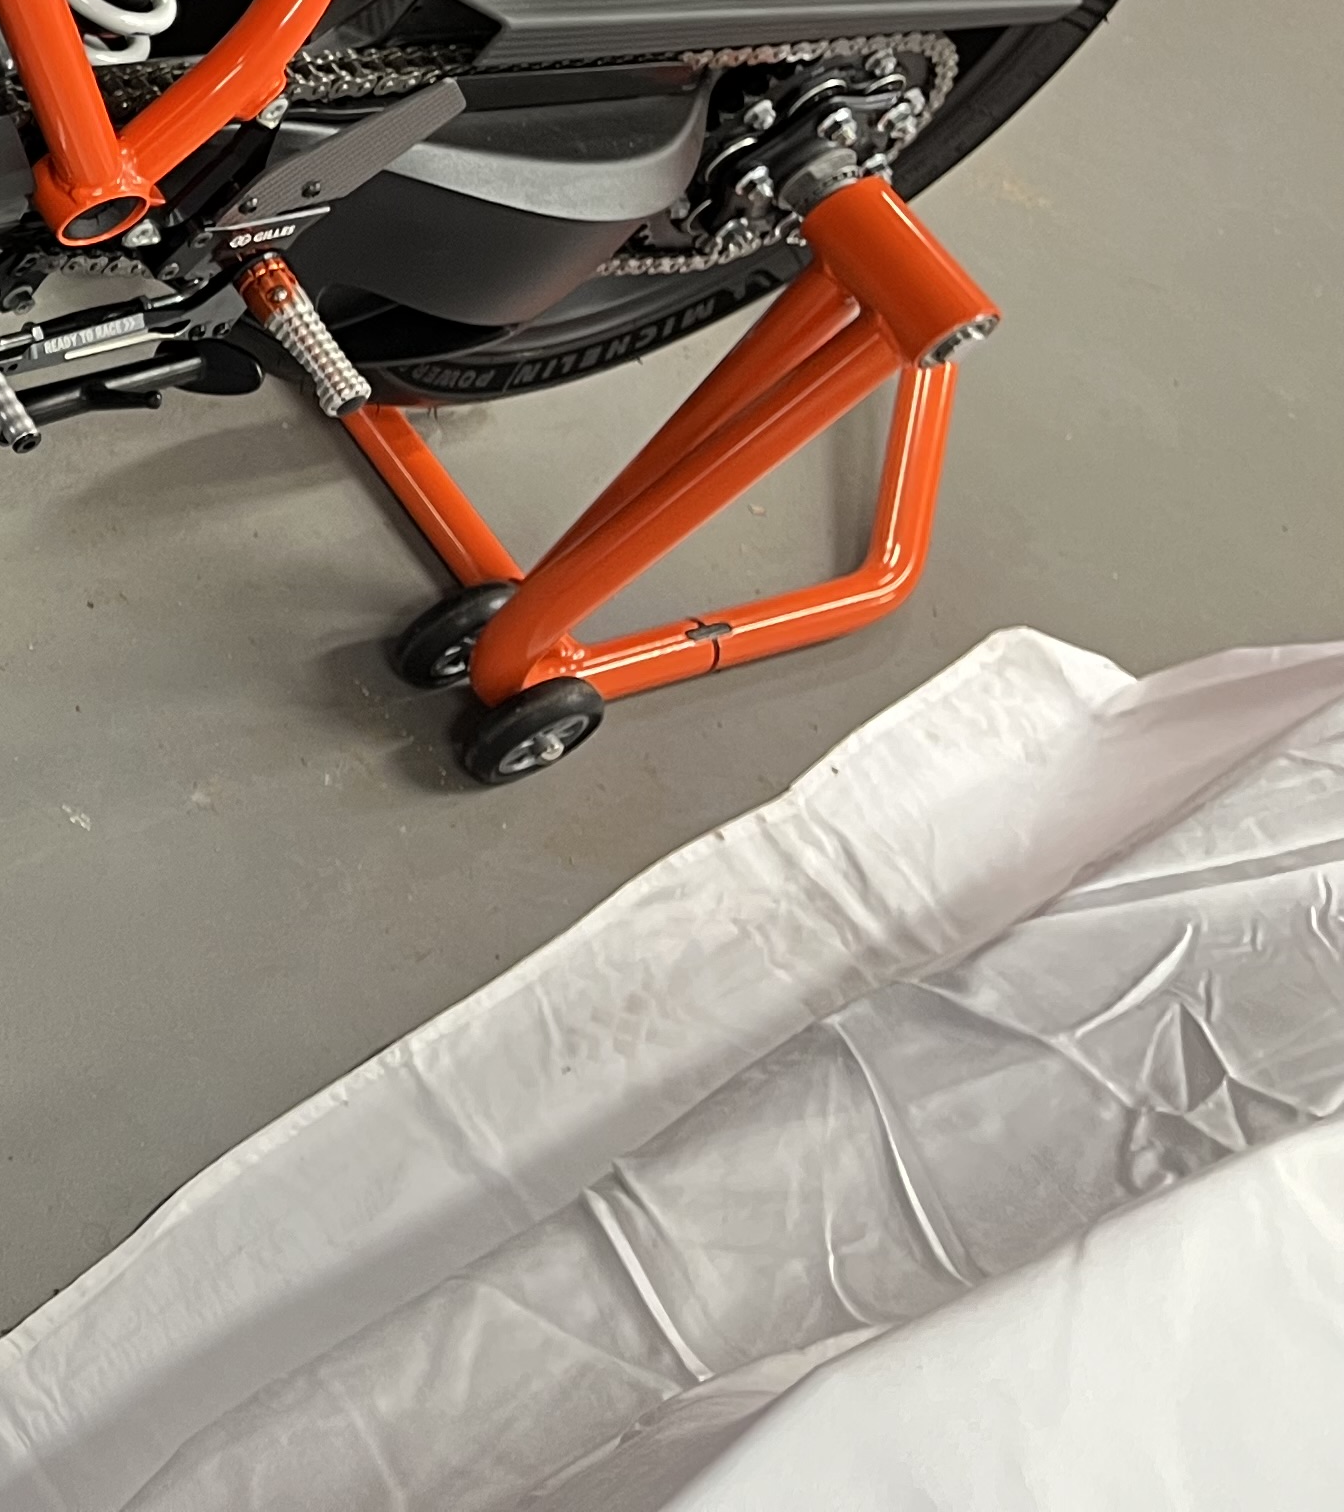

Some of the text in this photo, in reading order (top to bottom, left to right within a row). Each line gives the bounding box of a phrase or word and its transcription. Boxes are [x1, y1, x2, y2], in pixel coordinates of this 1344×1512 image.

[253, 225, 296, 243] GILLES
[44, 321, 123, 355] READY TO RACE
[411, 296, 718, 389] MICHELIN POWER
